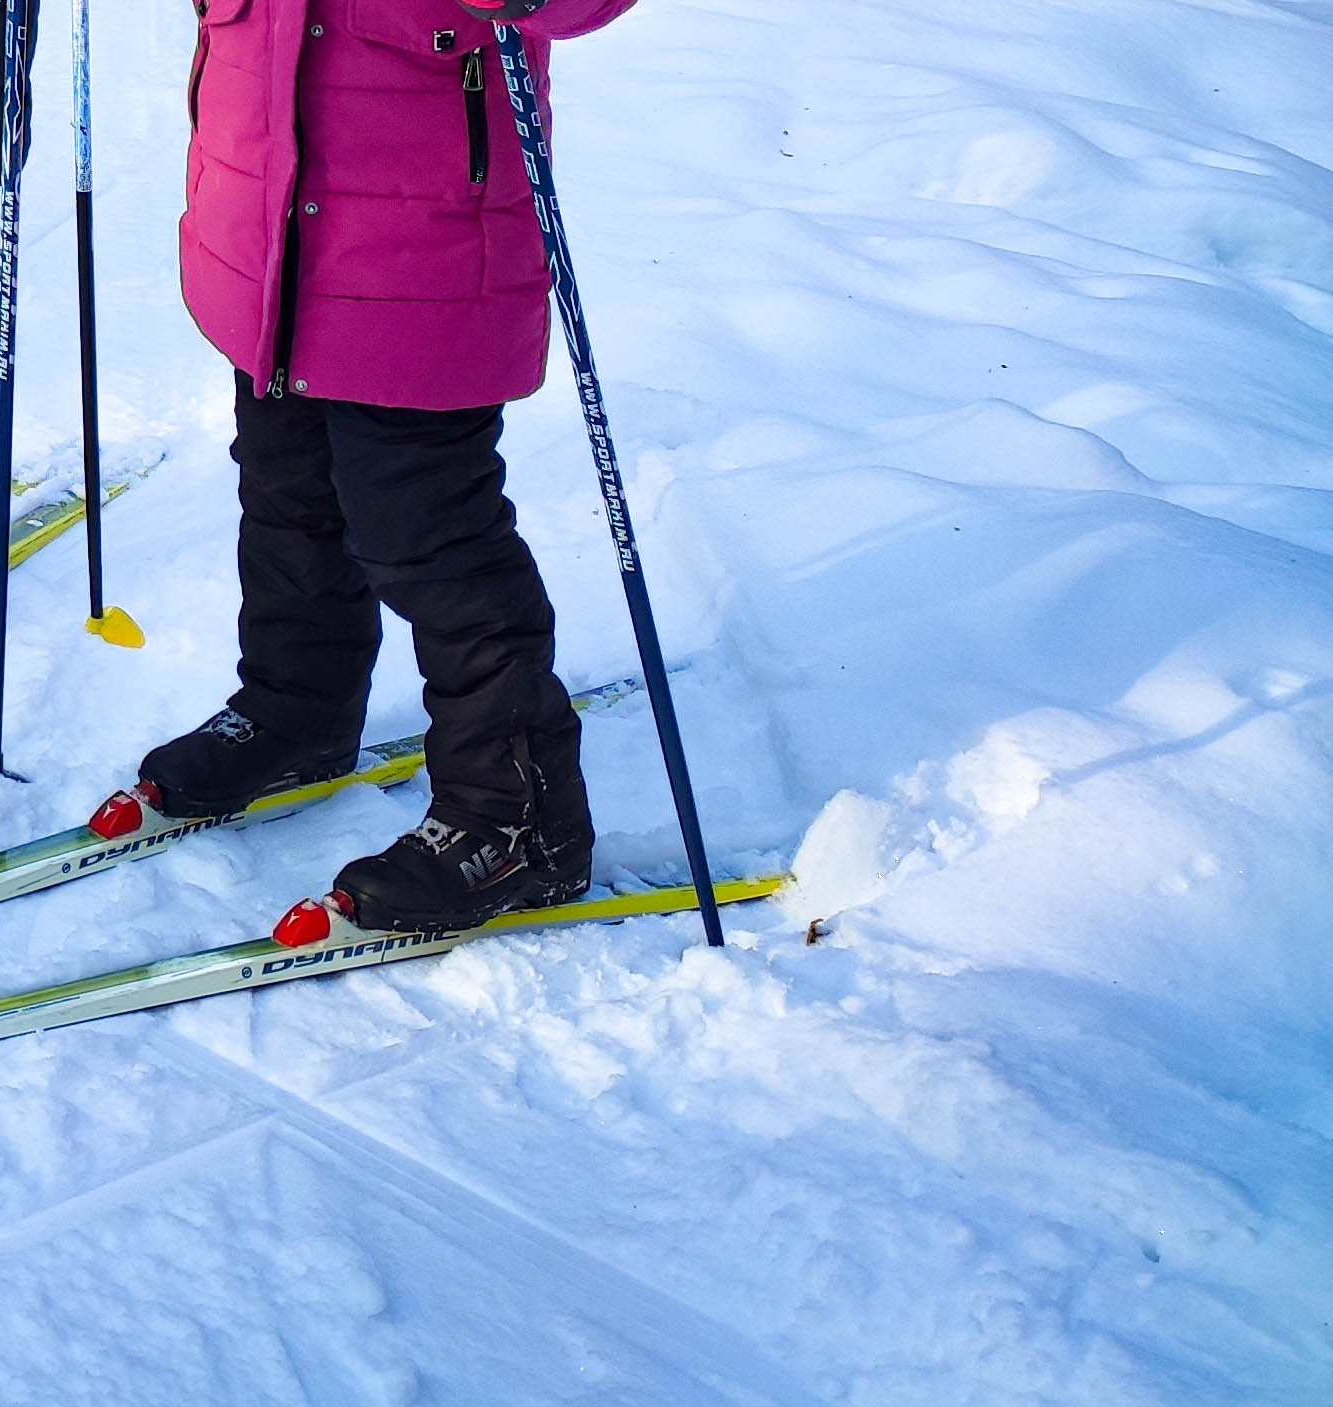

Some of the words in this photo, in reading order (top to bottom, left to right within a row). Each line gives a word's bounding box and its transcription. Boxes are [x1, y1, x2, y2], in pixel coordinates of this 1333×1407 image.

[0, 191, 15, 381] WWW.SPORTMAXIM.RU
[580, 371, 636, 572] WWW.SPORTMAXIM.RU
[78, 813, 245, 870] DYNAMIC
[261, 929, 461, 976] DYNAMIC
